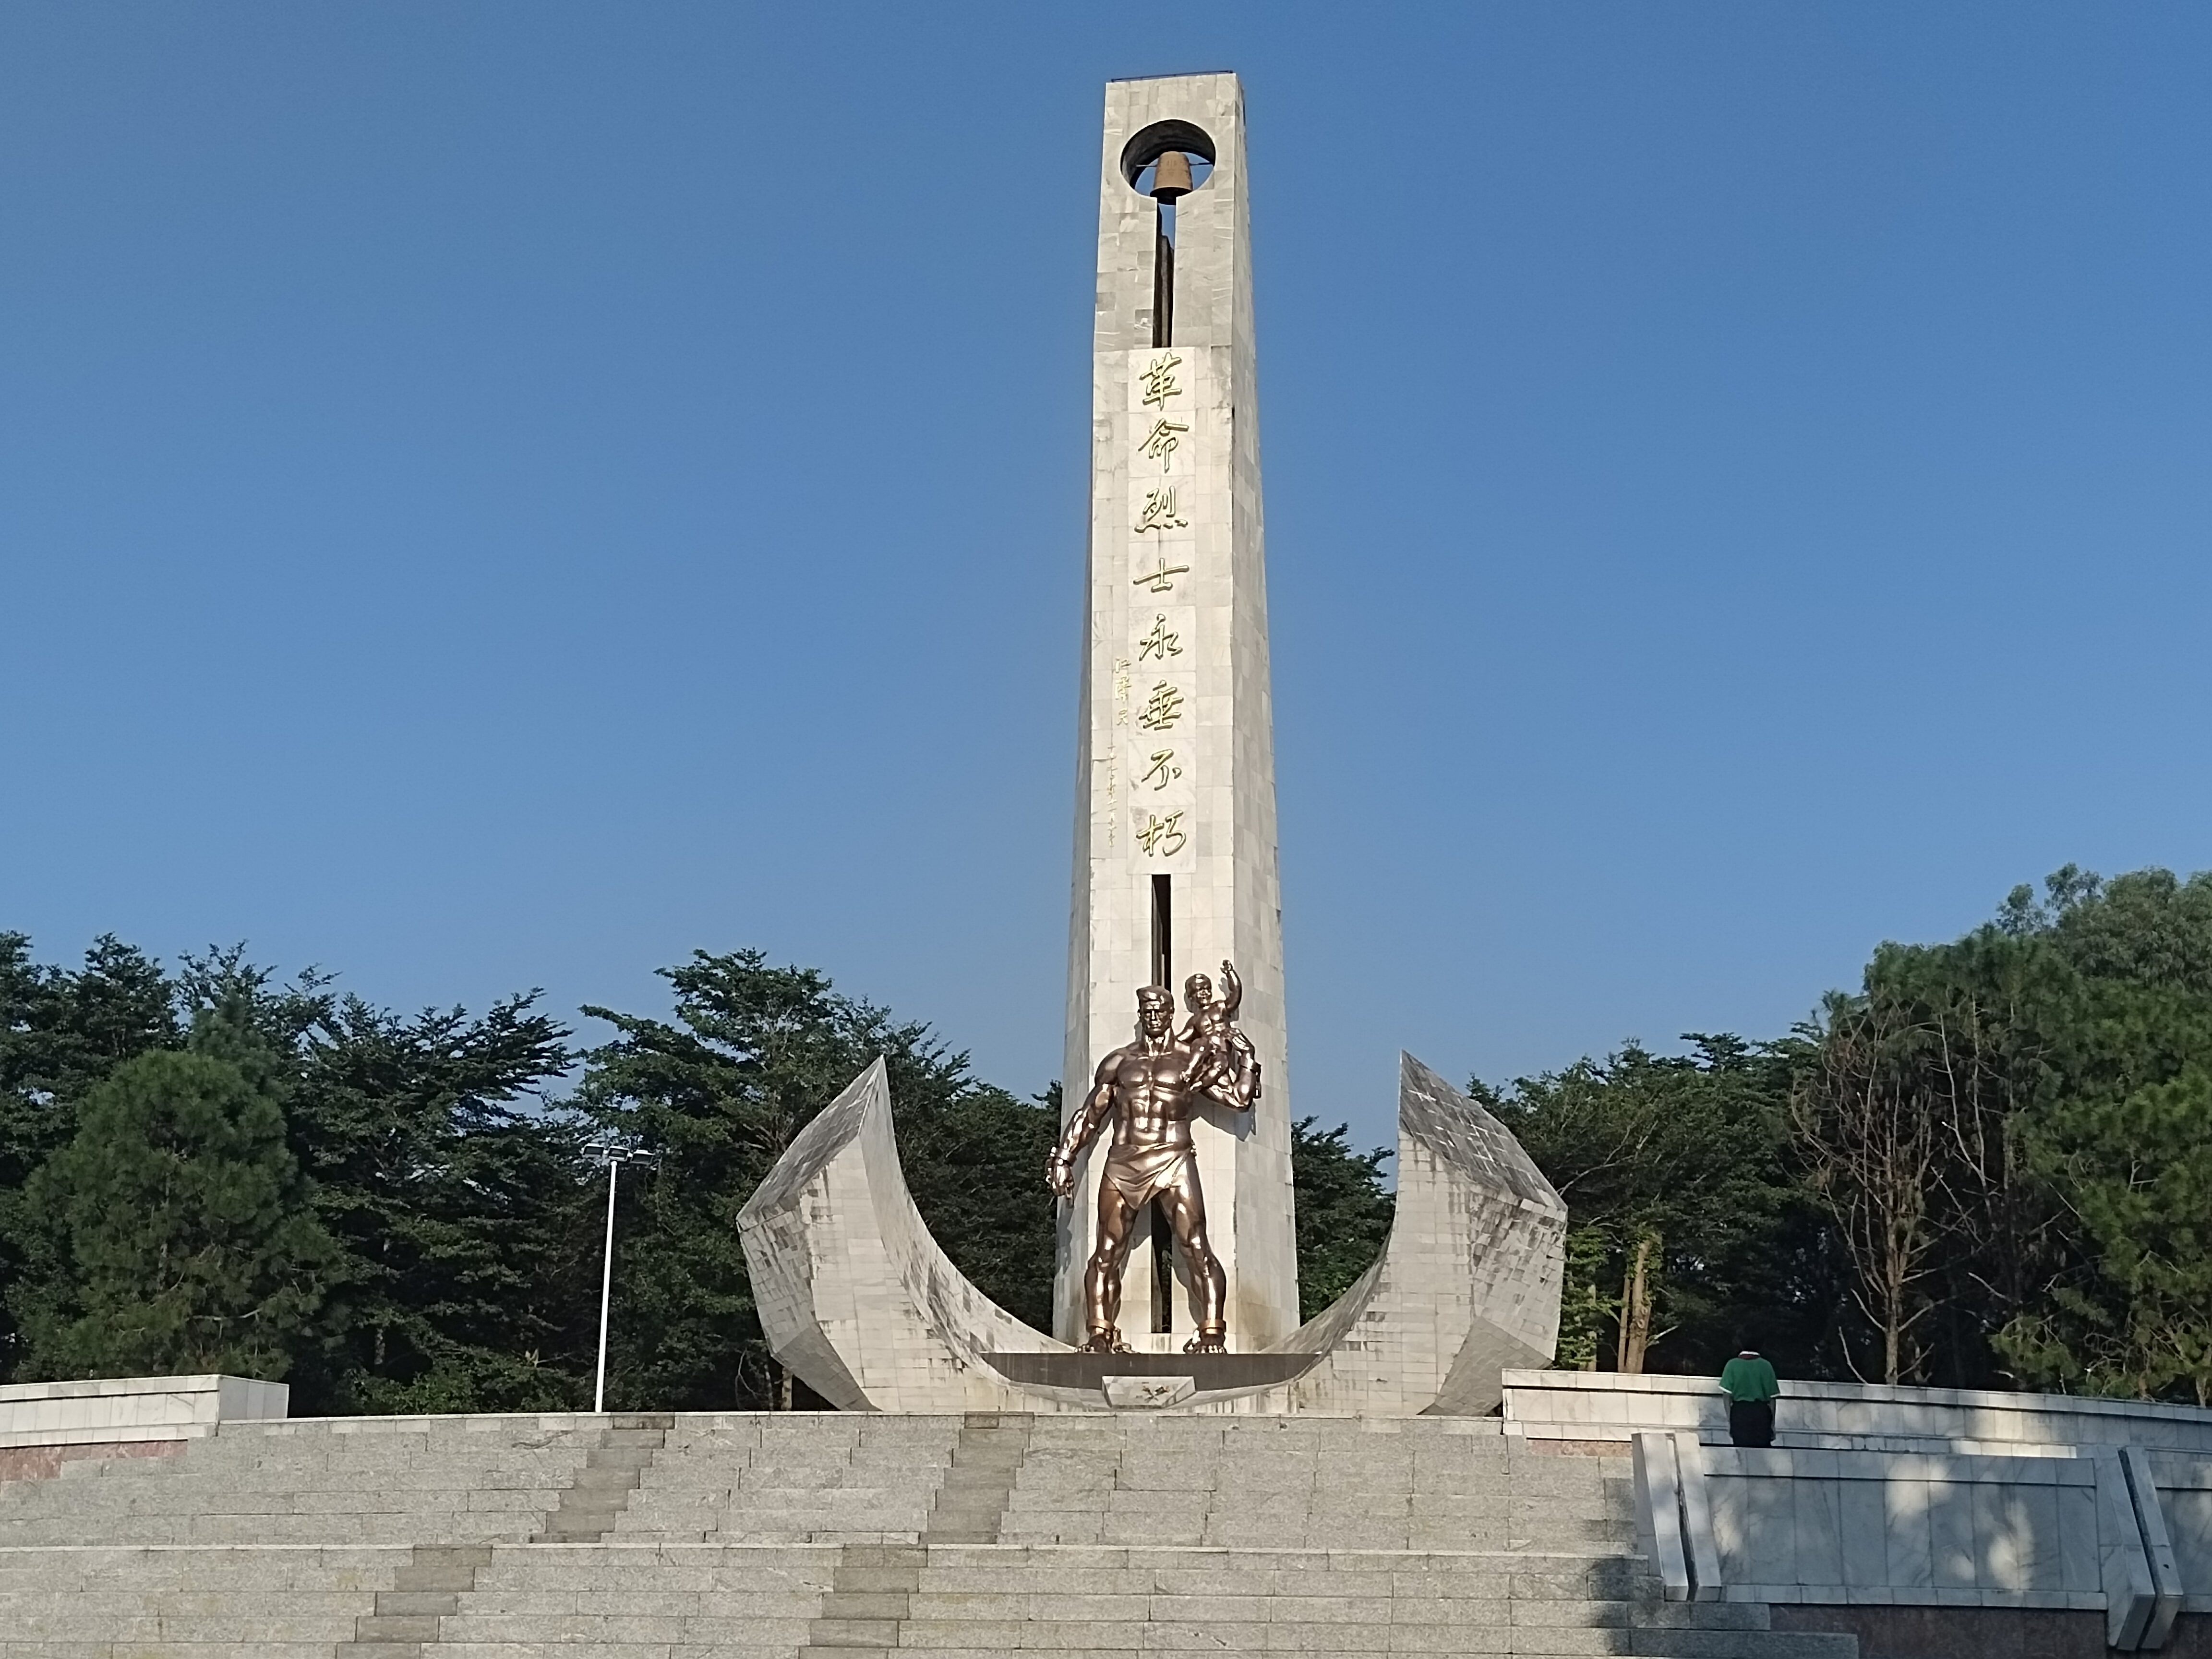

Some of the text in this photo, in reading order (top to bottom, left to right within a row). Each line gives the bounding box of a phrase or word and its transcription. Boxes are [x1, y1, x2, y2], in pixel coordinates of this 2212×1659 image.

[1133, 352, 1190, 857] 革命烈士永垂不朽
